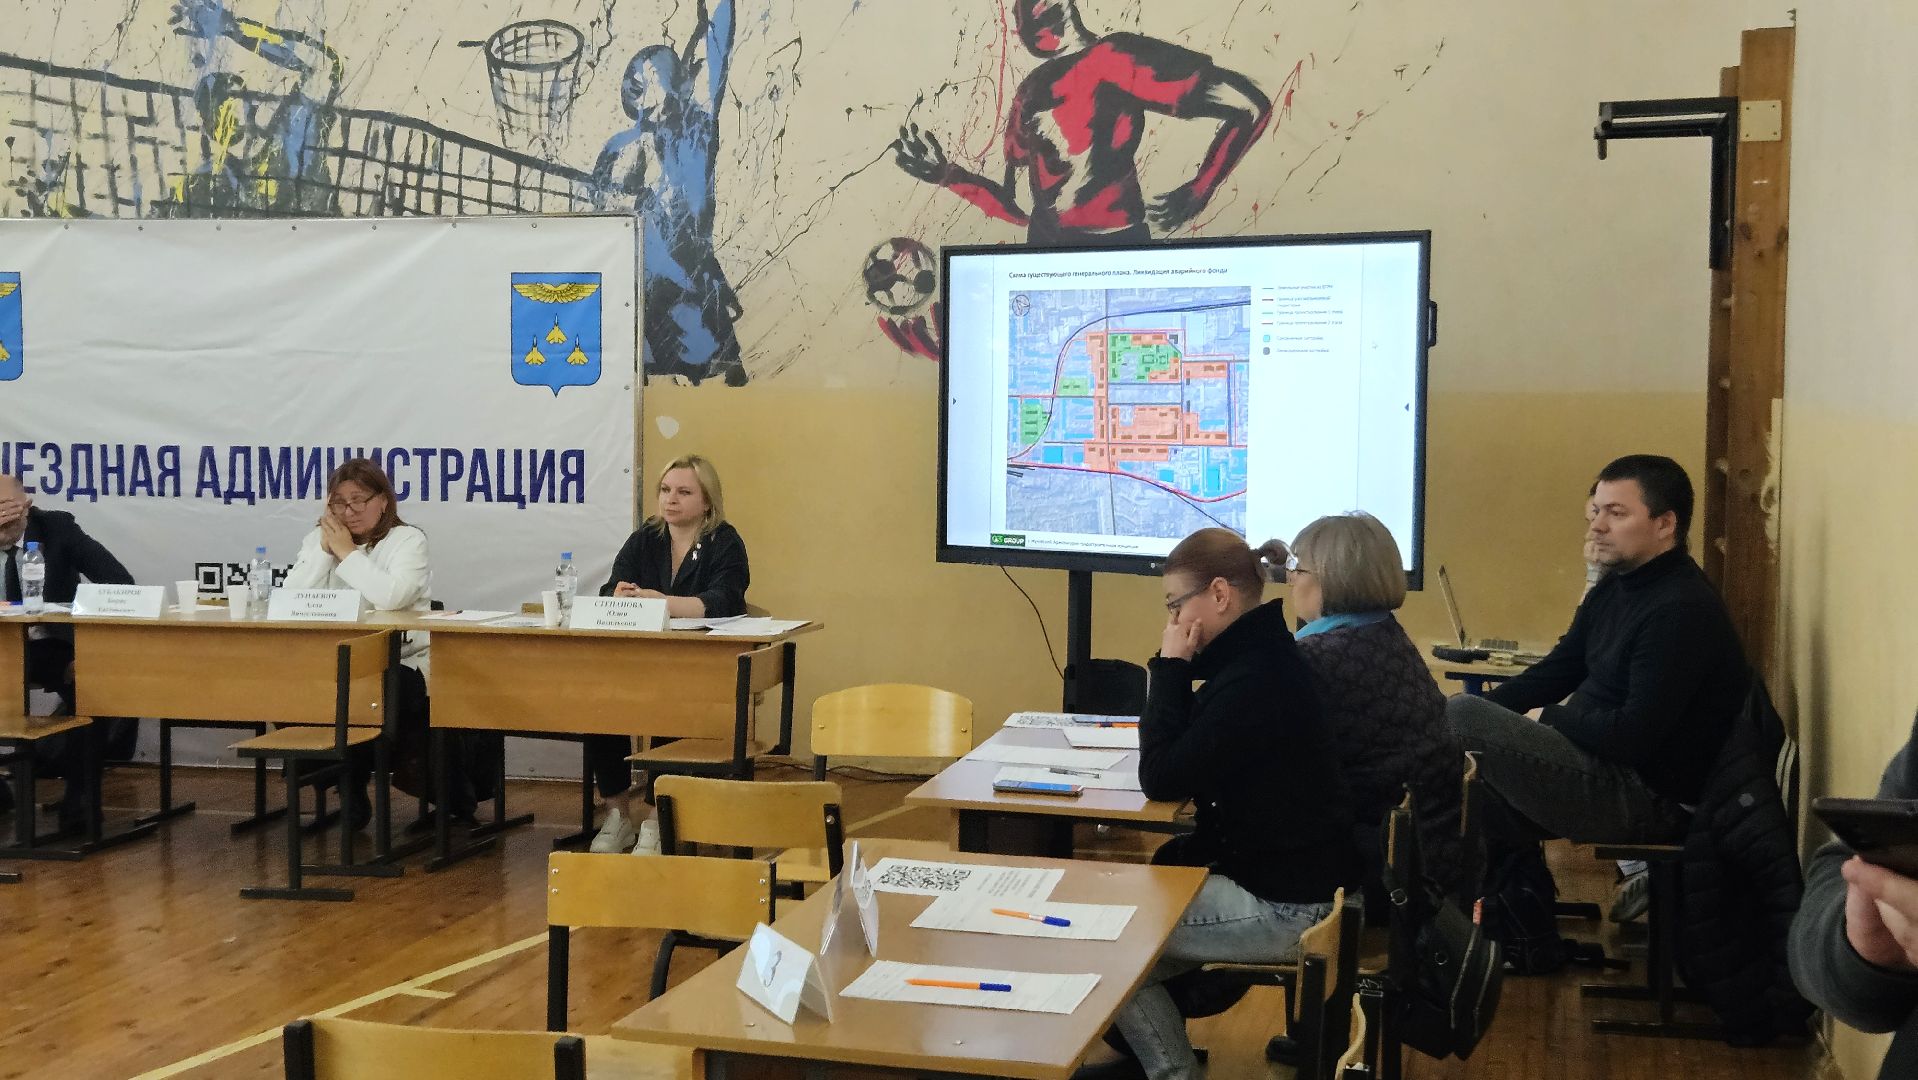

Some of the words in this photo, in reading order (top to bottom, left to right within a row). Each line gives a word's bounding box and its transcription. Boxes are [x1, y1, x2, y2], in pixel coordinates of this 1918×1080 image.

[1072, 269, 1111, 278] генерального
[1, 442, 181, 502] ЕЗДНАЯ
[594, 600, 643, 609] СТЕПАНОВА
